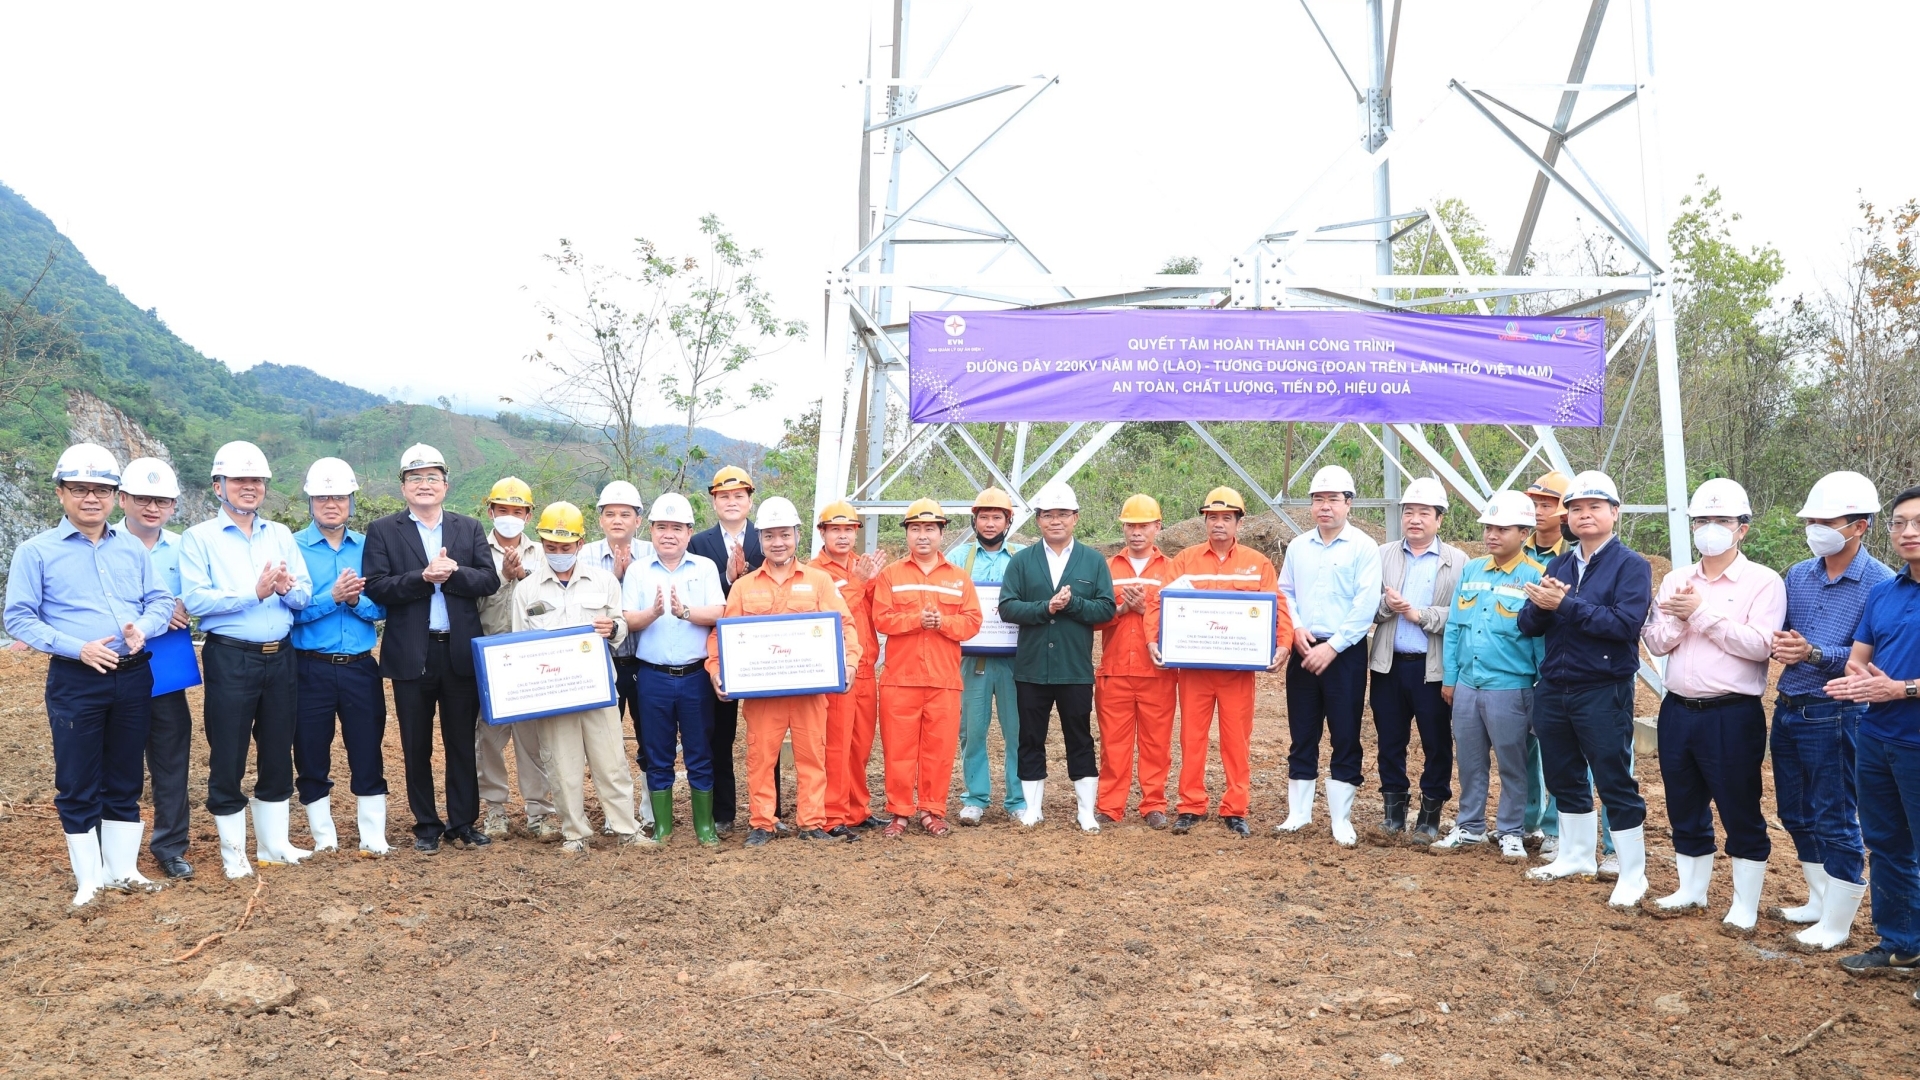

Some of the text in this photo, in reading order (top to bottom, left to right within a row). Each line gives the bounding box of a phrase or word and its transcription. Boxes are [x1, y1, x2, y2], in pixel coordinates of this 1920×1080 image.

[1128, 335, 1395, 352] QUYẾT TÂM HOÀN THÀNH CÔNG TRÌNH
[966, 358, 1018, 372] ĐƯỜNG
[1022, 358, 1052, 372] DÂY
[1056, 360, 1098, 372] 220KV
[1102, 358, 1132, 374] NẬM
[1137, 358, 1159, 372] MÔ
[1163, 358, 1201, 374] (LÀO)
[1213, 358, 1262, 372] TƯƠNG
[1267, 358, 1318, 372] DƯƠNG
[1322, 361, 1366, 374] (ĐOẠN
[1370, 359, 1406, 373] TRÊN
[1410, 360, 1448, 373] LÃNH
[1452, 360, 1480, 374] THỔ
[1484, 362, 1514, 377] VIỆT
[1518, 365, 1553, 379] NAM)
[1112, 378, 1411, 396] AN TOÀN, CHẤT LƯỢNG, TIẾN ĐỘ, HIỆU QUẢ
[1502, 582, 1523, 590] VNEC
